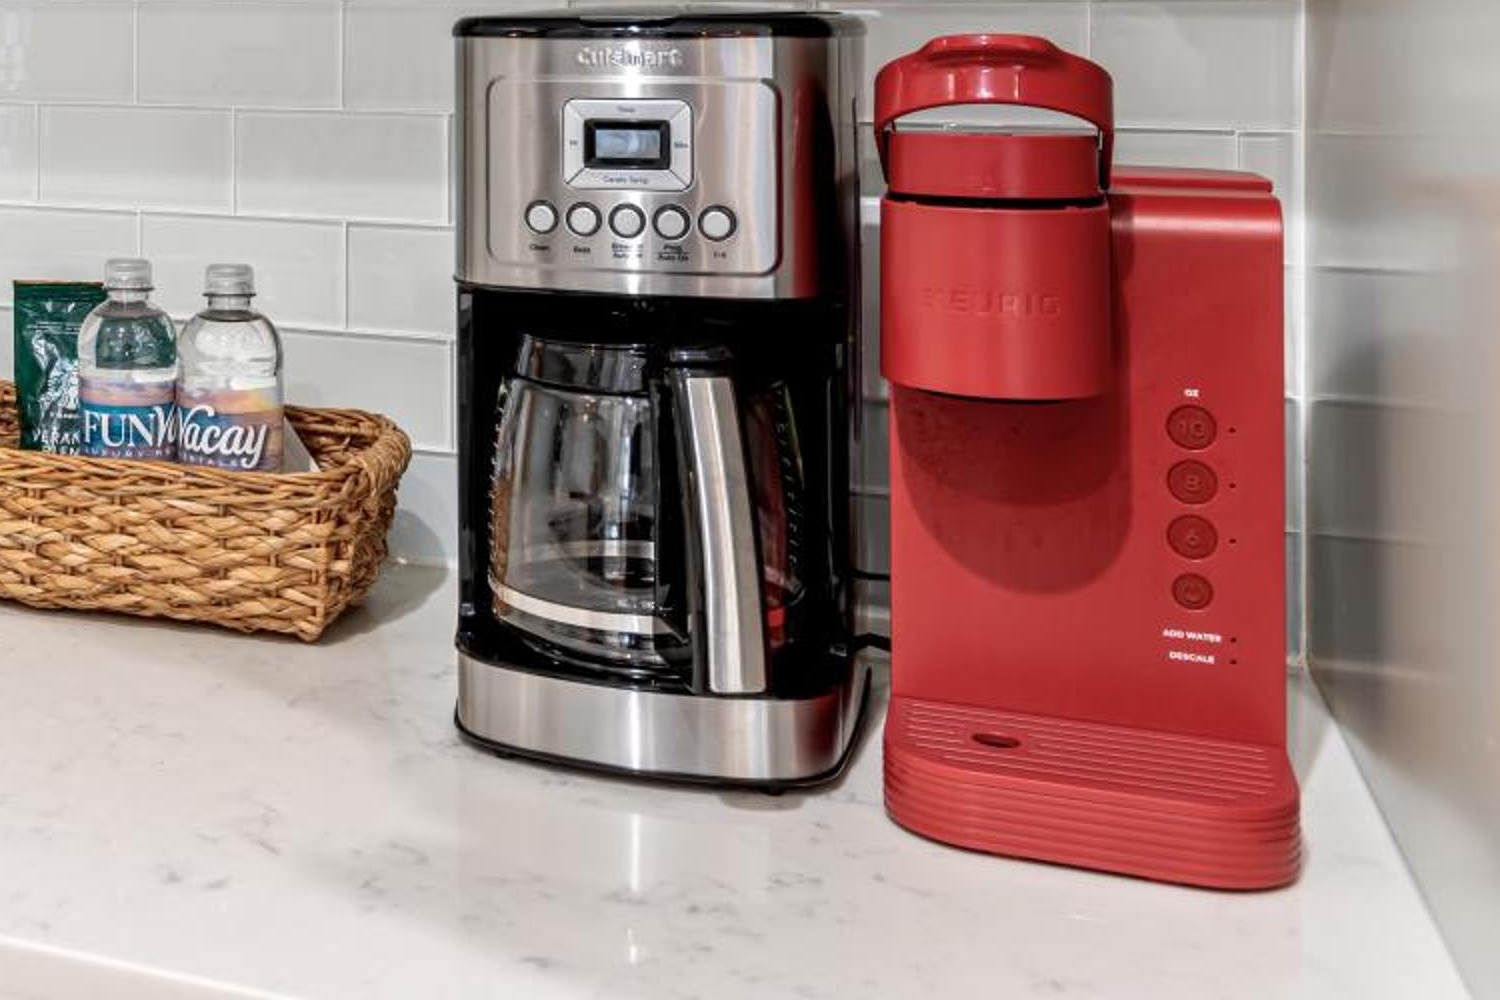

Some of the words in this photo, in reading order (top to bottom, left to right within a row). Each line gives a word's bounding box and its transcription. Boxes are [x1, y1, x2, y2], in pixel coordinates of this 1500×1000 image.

[1162, 628, 1185, 639] ADD
[1186, 631, 1222, 644] WATER
[1168, 650, 1215, 665] DESCALE
